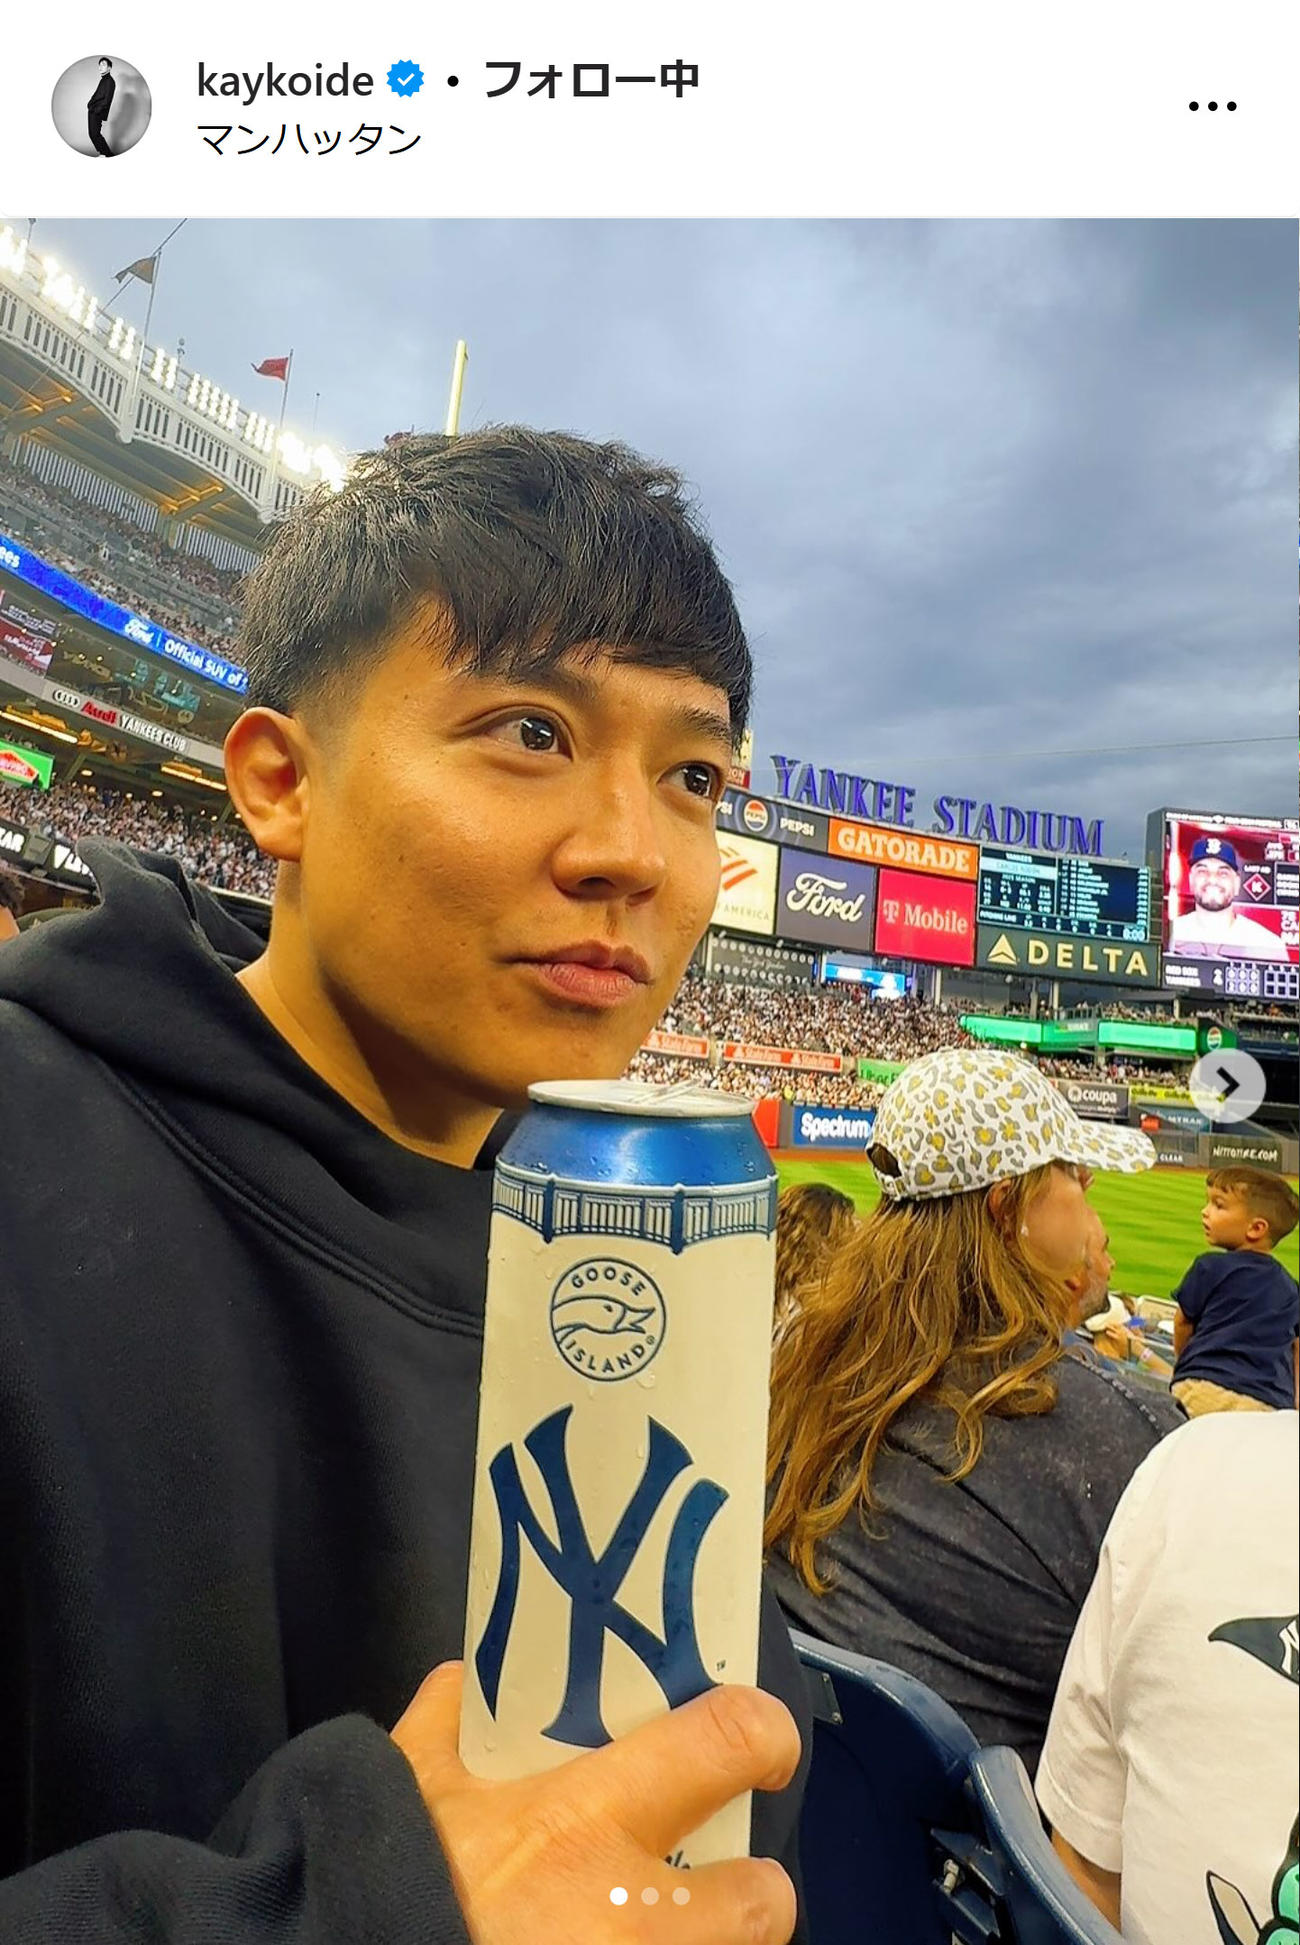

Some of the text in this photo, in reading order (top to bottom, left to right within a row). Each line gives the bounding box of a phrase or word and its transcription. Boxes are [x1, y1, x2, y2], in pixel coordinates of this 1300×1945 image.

[164, 639, 243, 685] Official SUV of
[81, 701, 187, 752] Audi YANKEES CLUB
[770, 754, 1104, 858] YANKEE STADIUM
[779, 817, 815, 837] PEPSI
[837, 828, 971, 873] GATORADE
[723, 904, 770, 921] AMERICA
[786, 872, 865, 923] Ford
[904, 902, 968, 935] Mobile
[1027, 938, 1149, 978] DELTA
[1082, 1090, 1117, 1104] coupa
[800, 1113, 870, 1141] Spectrum
[571, 1267, 645, 1297] GOOSE
[565, 1339, 645, 1373] ISLAND
